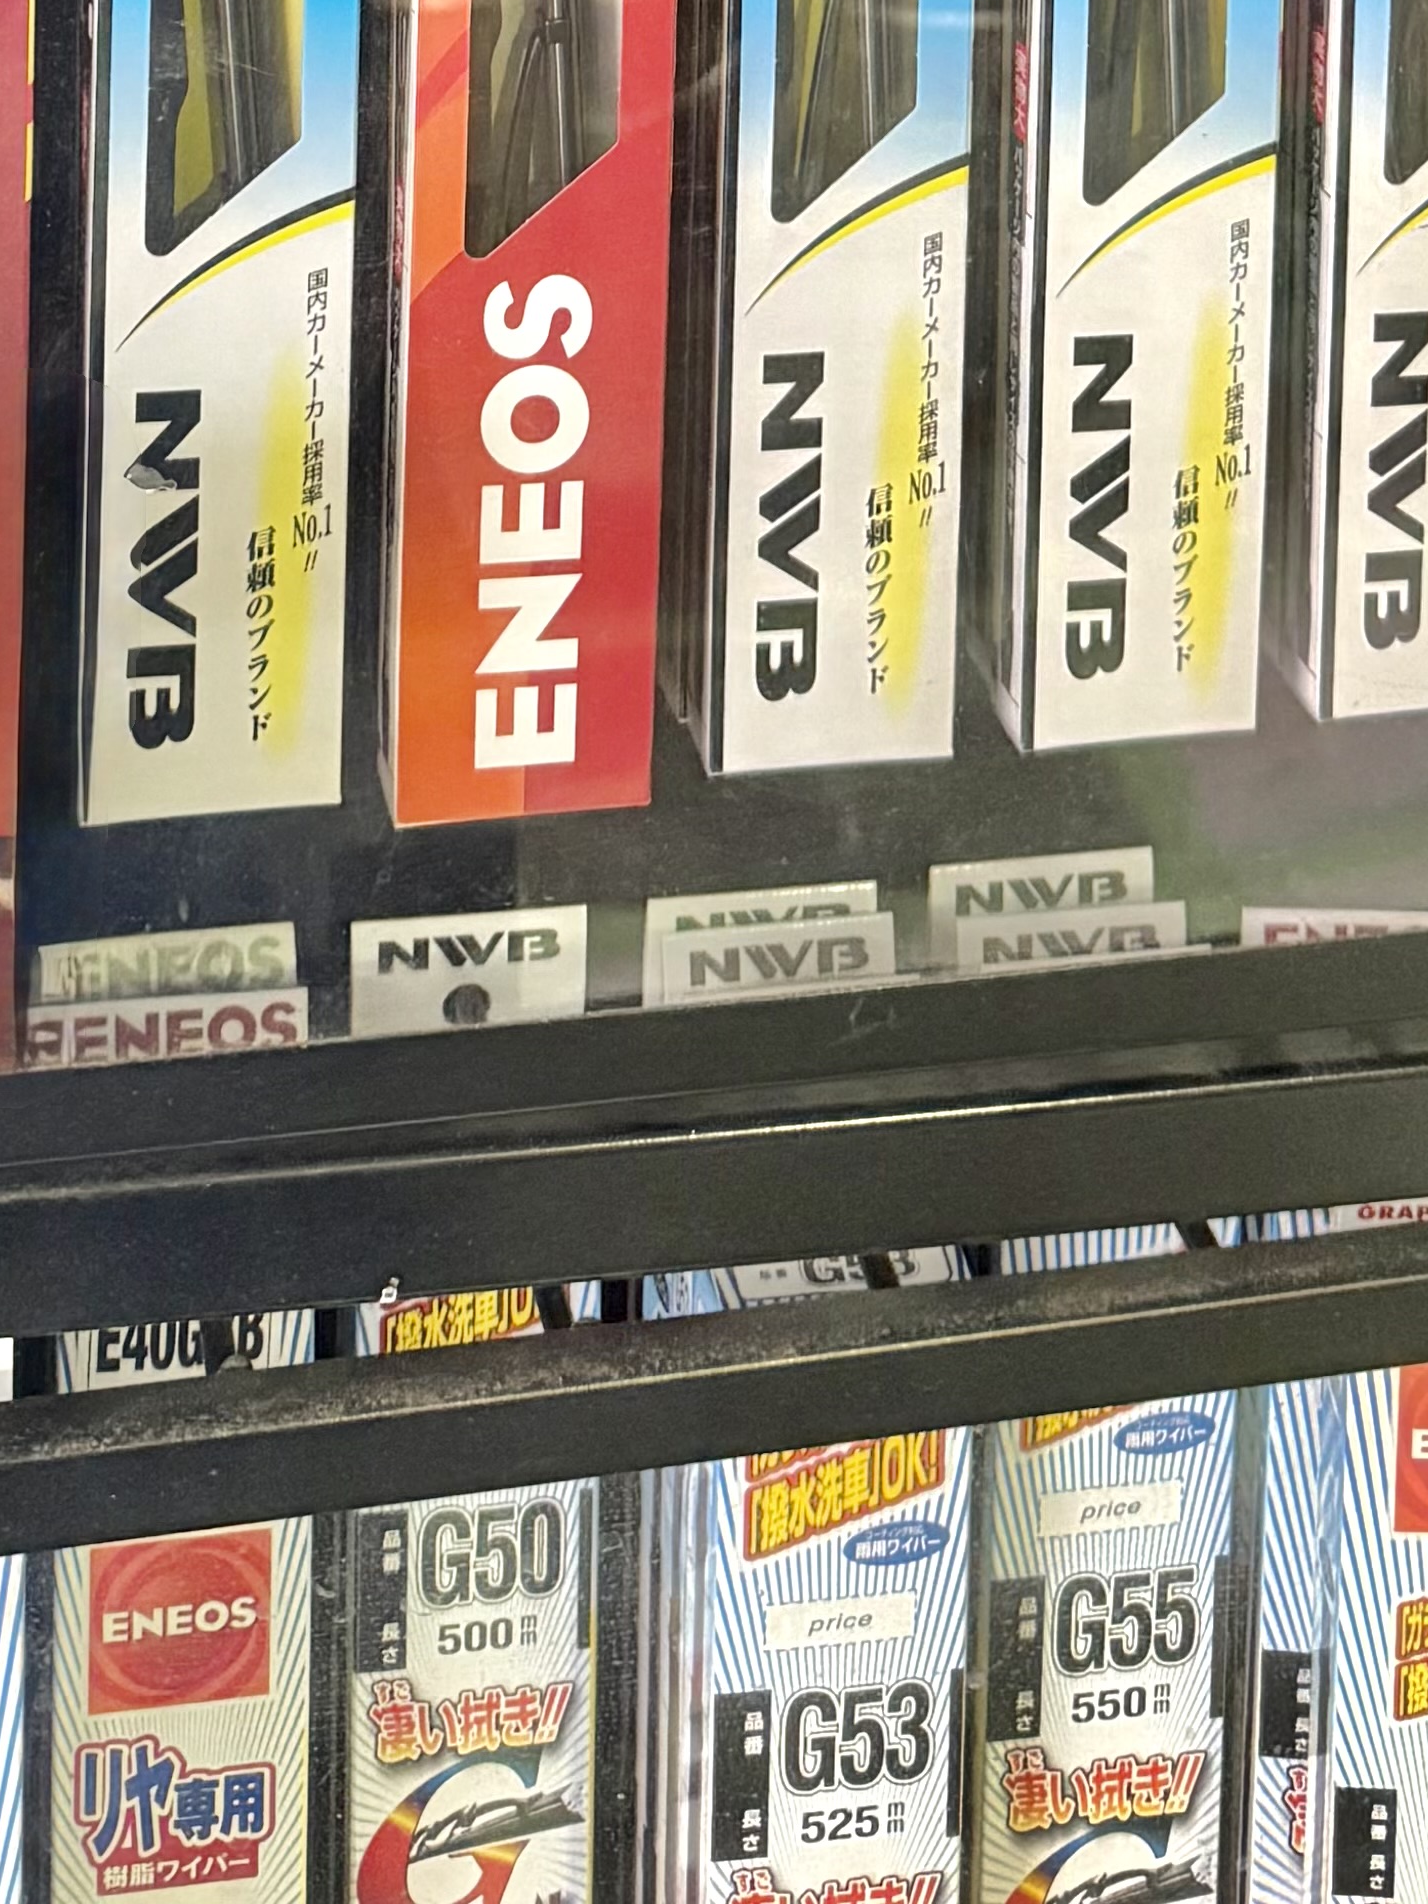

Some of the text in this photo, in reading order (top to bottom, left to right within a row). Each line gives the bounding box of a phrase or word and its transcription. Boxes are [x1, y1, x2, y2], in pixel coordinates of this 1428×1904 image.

[473, 273, 594, 771] ENEOS
[754, 350, 826, 703] NWB
[1065, 335, 1134, 680] NWB
[124, 390, 202, 751] NWB
[246, 525, 278, 742] 信頼のブランド
[956, 870, 1129, 917] NWB
[378, 928, 561, 974] NWB
[689, 938, 870, 987] NWB
[418, 1497, 567, 1609] G50
[1080, 1498, 1141, 1523] price
[102, 1595, 258, 1644] ENEOS
[808, 1610, 873, 1636] price
[1053, 1565, 1201, 1676] G55
[780, 1679, 935, 1795] G53
[83, 1744, 266, 1857] リヤ専用
[103, 1852, 250, 1888] 樹脂ワイパー
